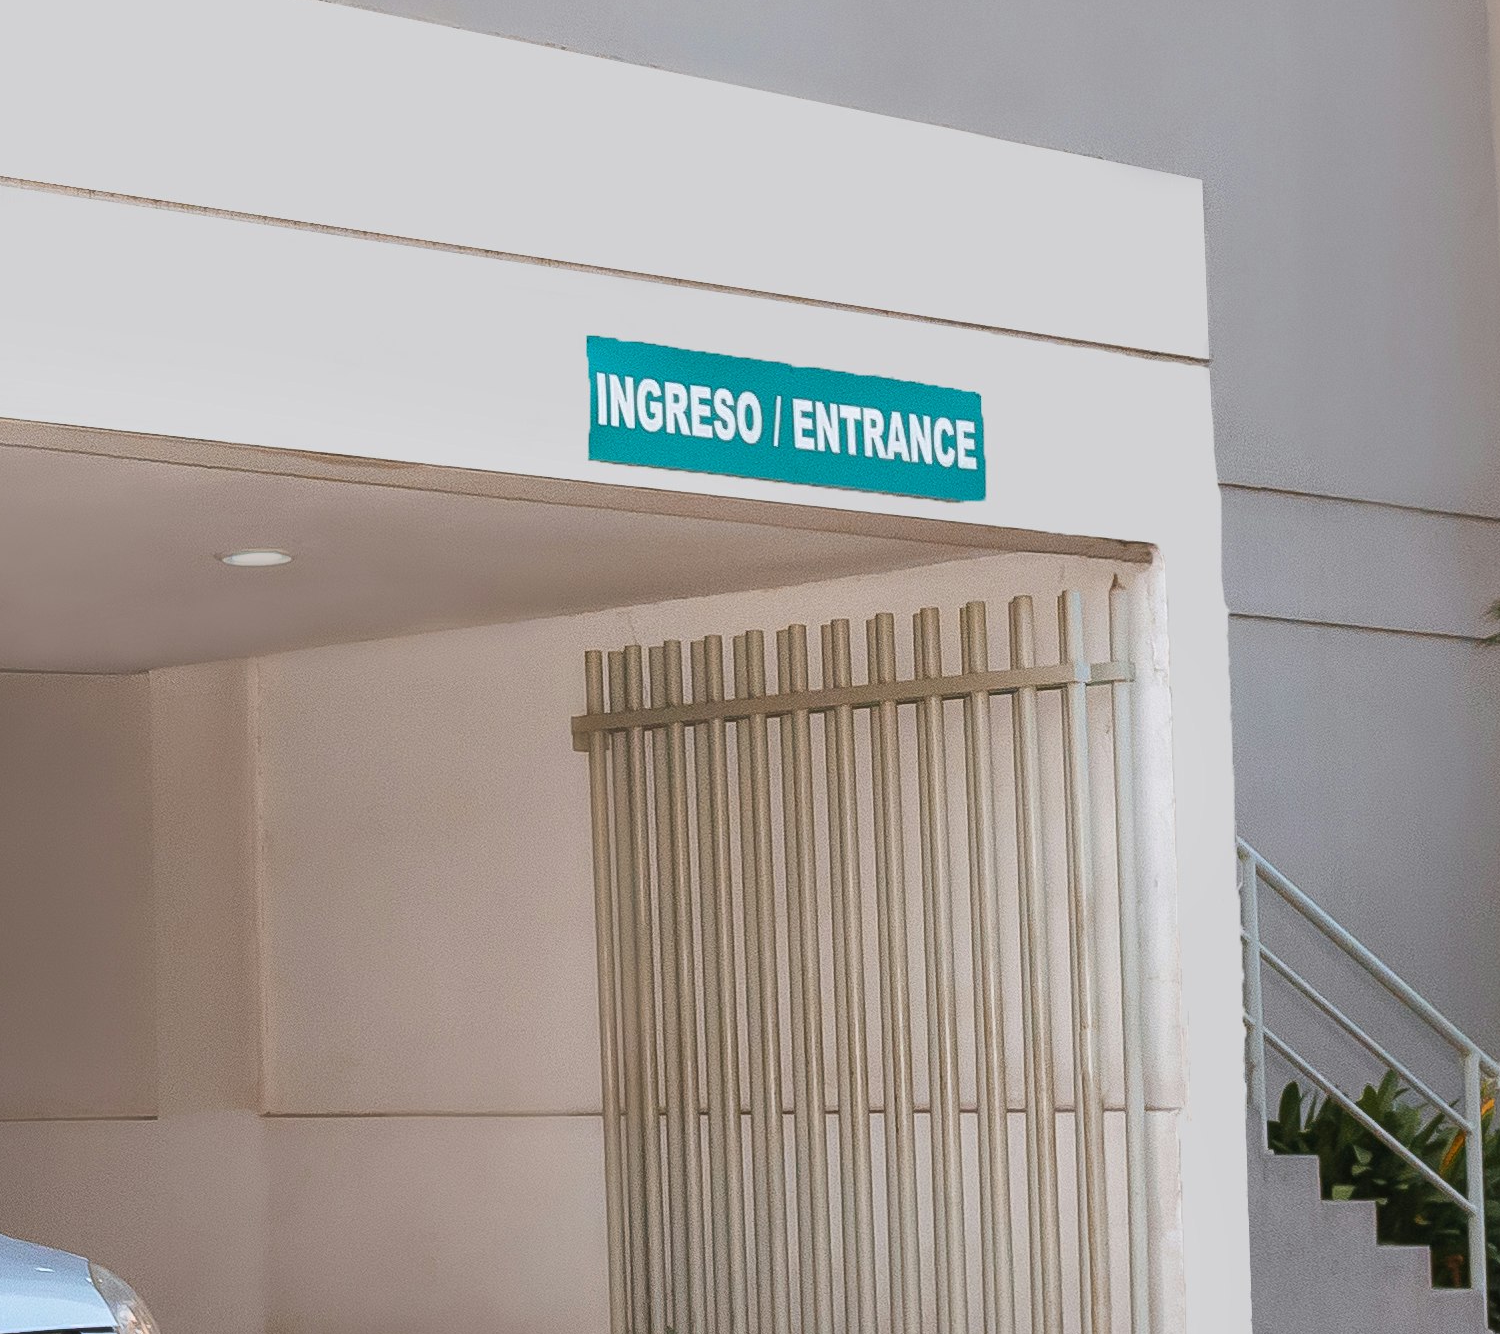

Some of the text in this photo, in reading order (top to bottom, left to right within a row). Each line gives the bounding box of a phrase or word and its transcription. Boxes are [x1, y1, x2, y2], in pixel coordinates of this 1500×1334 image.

[595, 371, 978, 471] INGRESO / ENTRANCE
